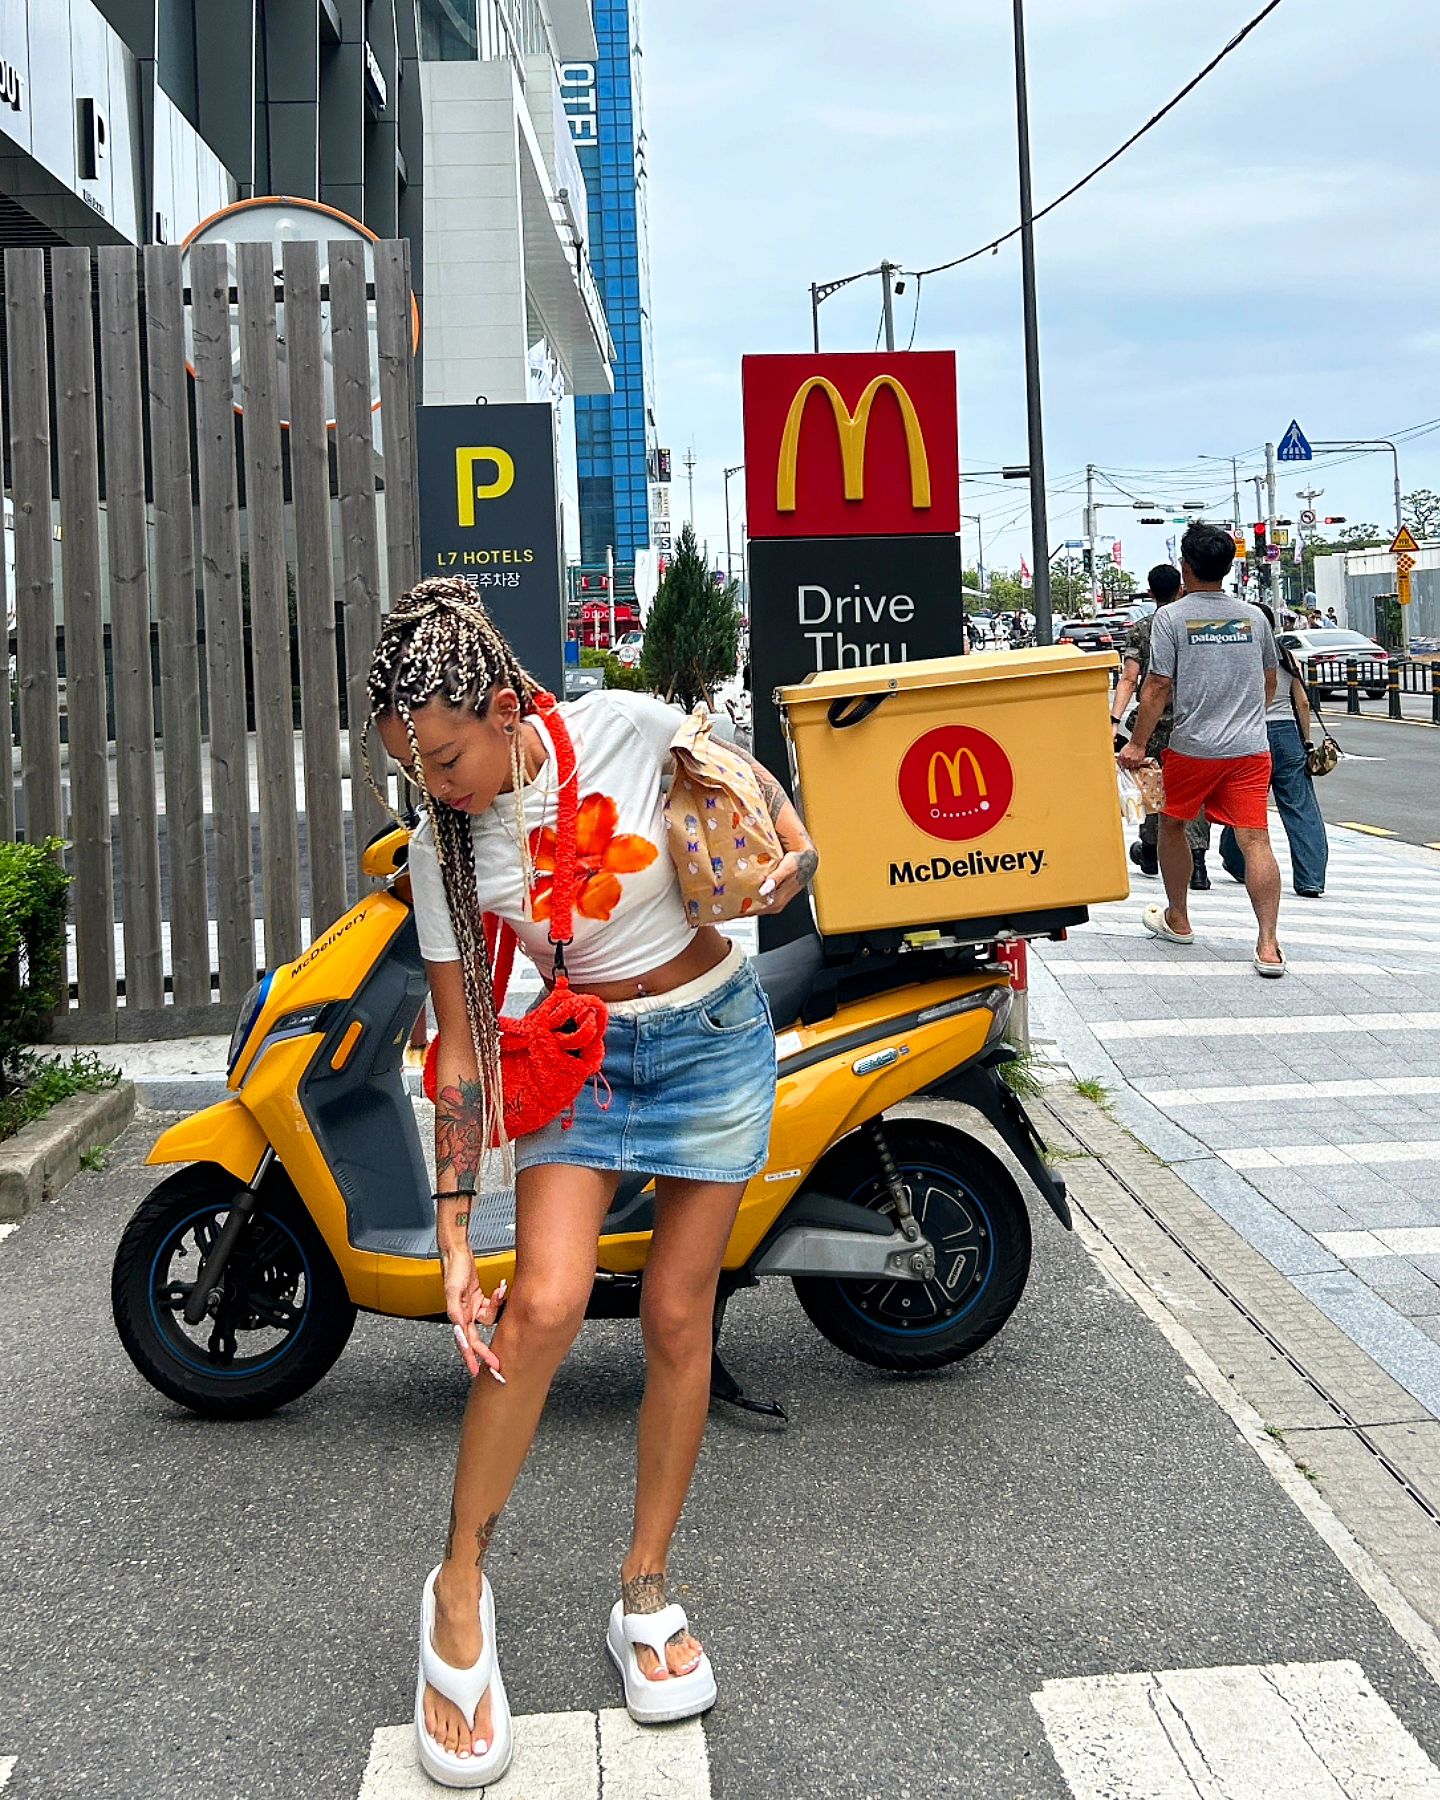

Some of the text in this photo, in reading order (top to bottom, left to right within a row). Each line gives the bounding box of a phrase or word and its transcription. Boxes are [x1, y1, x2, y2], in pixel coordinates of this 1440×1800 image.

[456, 446, 515, 526] P
[437, 549, 534, 566] L7 HOTELS
[453, 572, 521, 588] 료주차장
[798, 584, 915, 625] Drive
[803, 632, 907, 672] Thru
[1190, 633, 1248, 644] patagonia
[889, 850, 1045, 886] McDelivery
[291, 909, 368, 979] McDelivery
